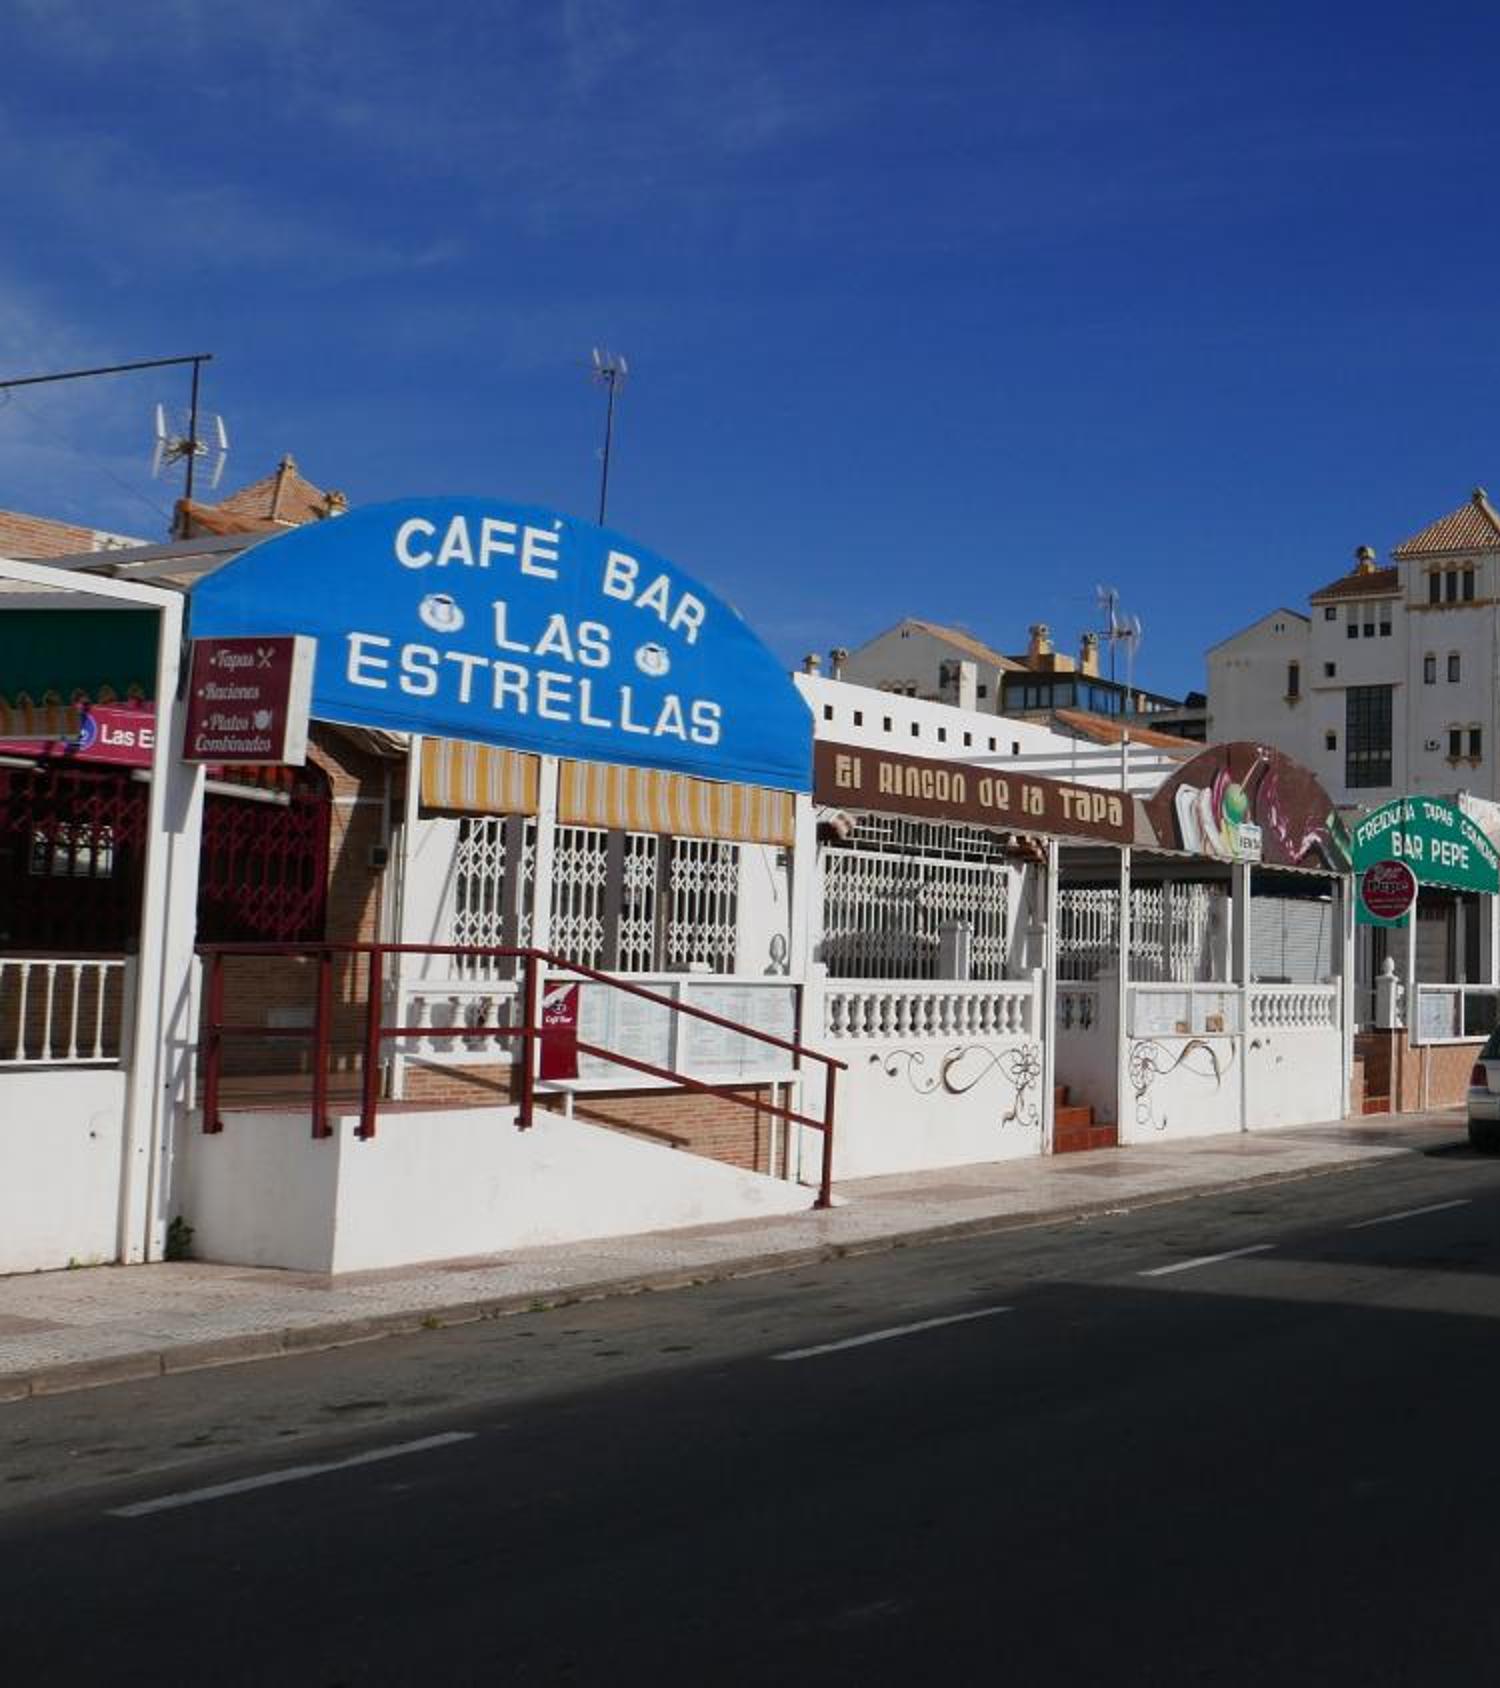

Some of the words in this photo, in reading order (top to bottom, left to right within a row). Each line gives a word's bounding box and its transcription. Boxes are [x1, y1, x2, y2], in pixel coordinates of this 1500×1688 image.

[603, 550, 706, 645] BAR
[491, 600, 611, 669] LAS
[217, 649, 254, 672] Tapas
[206, 683, 260, 700] Raciones
[346, 631, 722, 746] ESTRELLAS
[210, 712, 249, 730] Platos
[101, 723, 135, 747] Las
[195, 733, 271, 752] Combinados
[1423, 802, 1454, 827] TAPAS
[1391, 831, 1423, 861] BAR
[1431, 838, 1470, 870] PEPE
